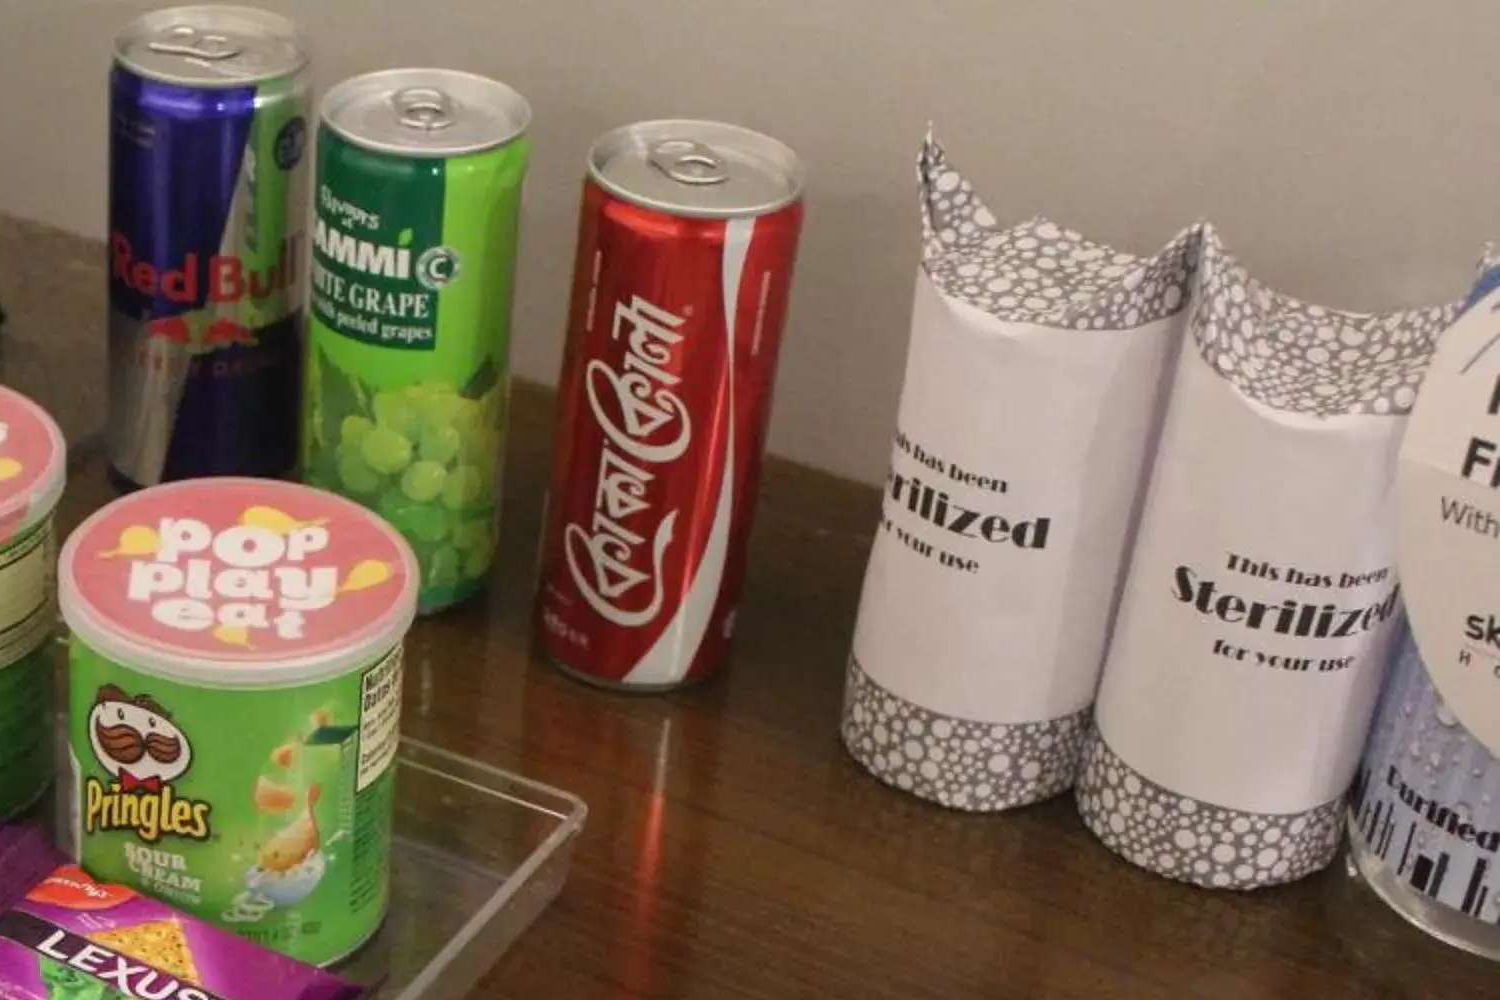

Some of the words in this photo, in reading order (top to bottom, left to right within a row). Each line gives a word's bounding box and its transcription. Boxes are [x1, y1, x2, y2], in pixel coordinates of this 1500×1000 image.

[112, 232, 198, 303] Red
[209, 233, 299, 304] Bull
[313, 220, 412, 279] AMMI
[349, 282, 430, 319] GRAPE
[381, 322, 433, 344] grapes
[913, 444, 944, 473] has
[949, 463, 1008, 494] been
[888, 472, 1052, 549] rilized
[158, 517, 329, 568] pop
[939, 550, 980, 573] use
[127, 560, 338, 612] play
[1226, 552, 1280, 582] This
[1285, 567, 1333, 588] has
[1339, 566, 1390, 588] been
[151, 597, 307, 640] eat
[1171, 564, 1401, 639] Sterilized
[1213, 639, 1250, 661] for
[1255, 651, 1316, 672] your
[1319, 655, 1356, 672] use
[86, 776, 212, 844] Pringles
[124, 842, 188, 871] SOUR
[128, 857, 203, 892] CREAM
